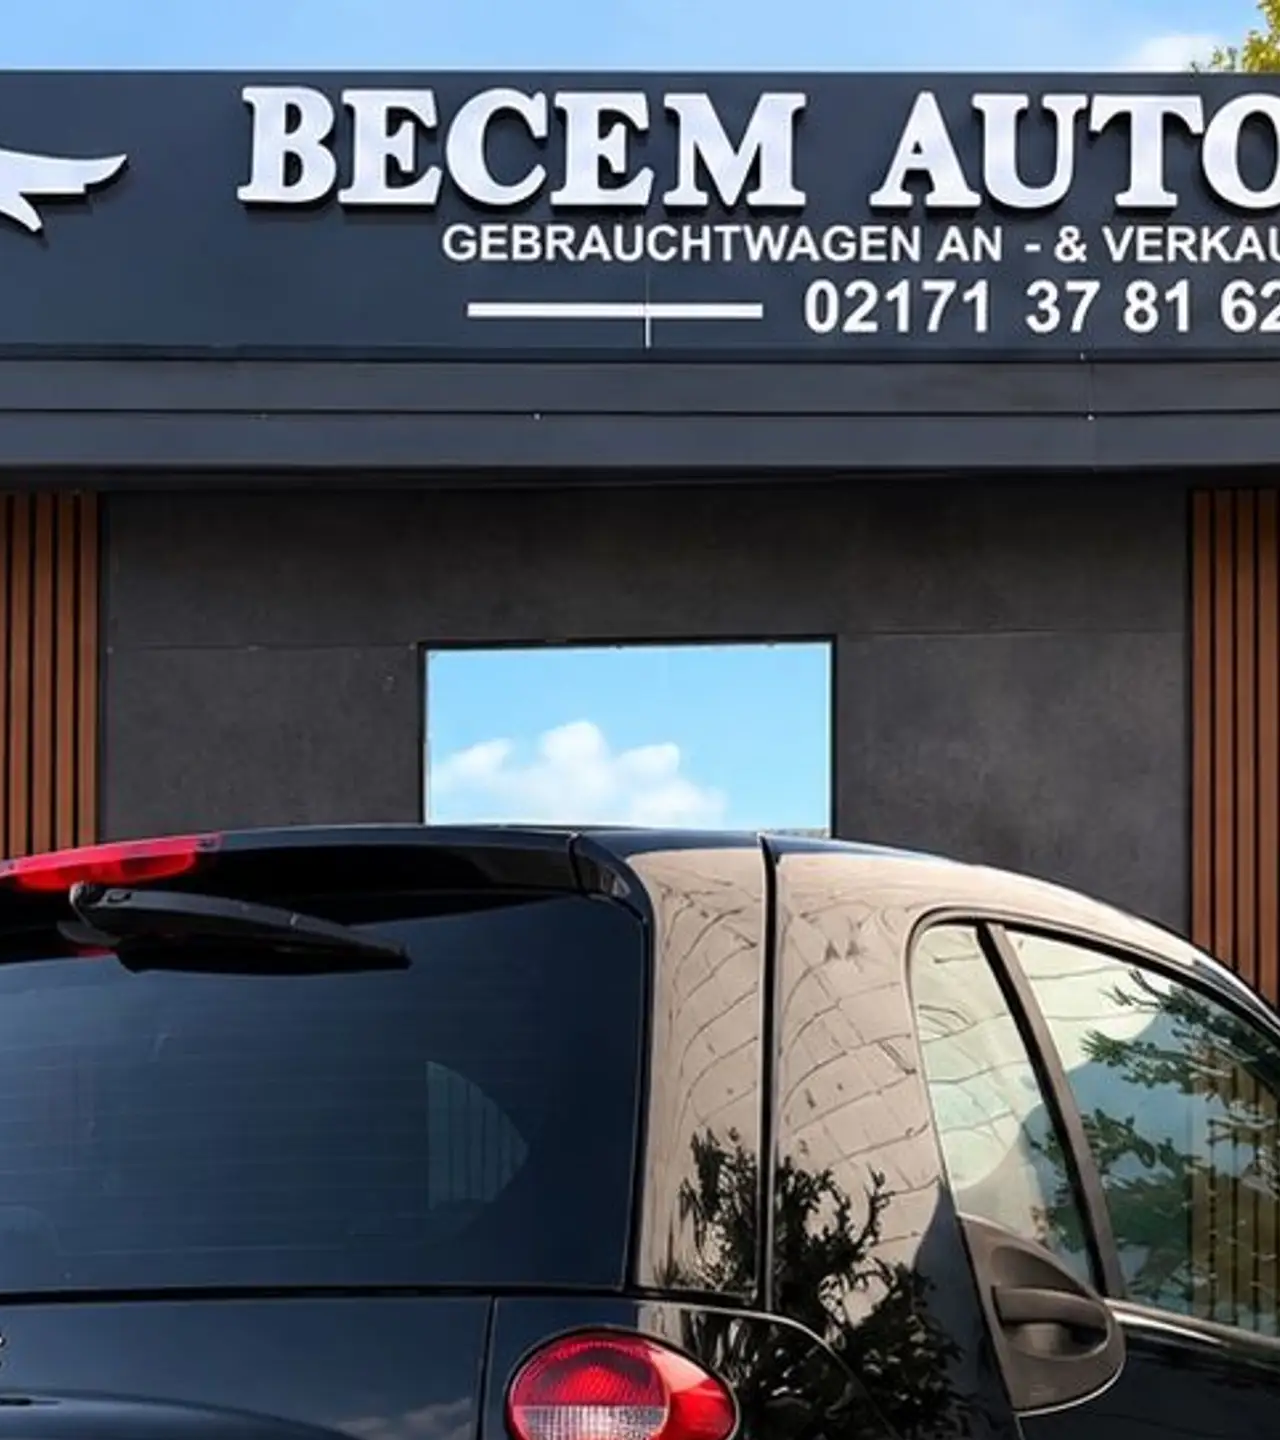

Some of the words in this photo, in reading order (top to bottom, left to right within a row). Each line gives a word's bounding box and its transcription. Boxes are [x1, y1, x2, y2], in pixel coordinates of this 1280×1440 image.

[236, 86, 808, 207] BECEM
[441, 224, 921, 263] GEBRAUCHTWAGEN
[936, 225, 1003, 263] AN
[1053, 225, 1088, 263] &
[804, 279, 990, 334] 02171
[1025, 279, 1101, 334] 37
[1123, 279, 1190, 334] 81
